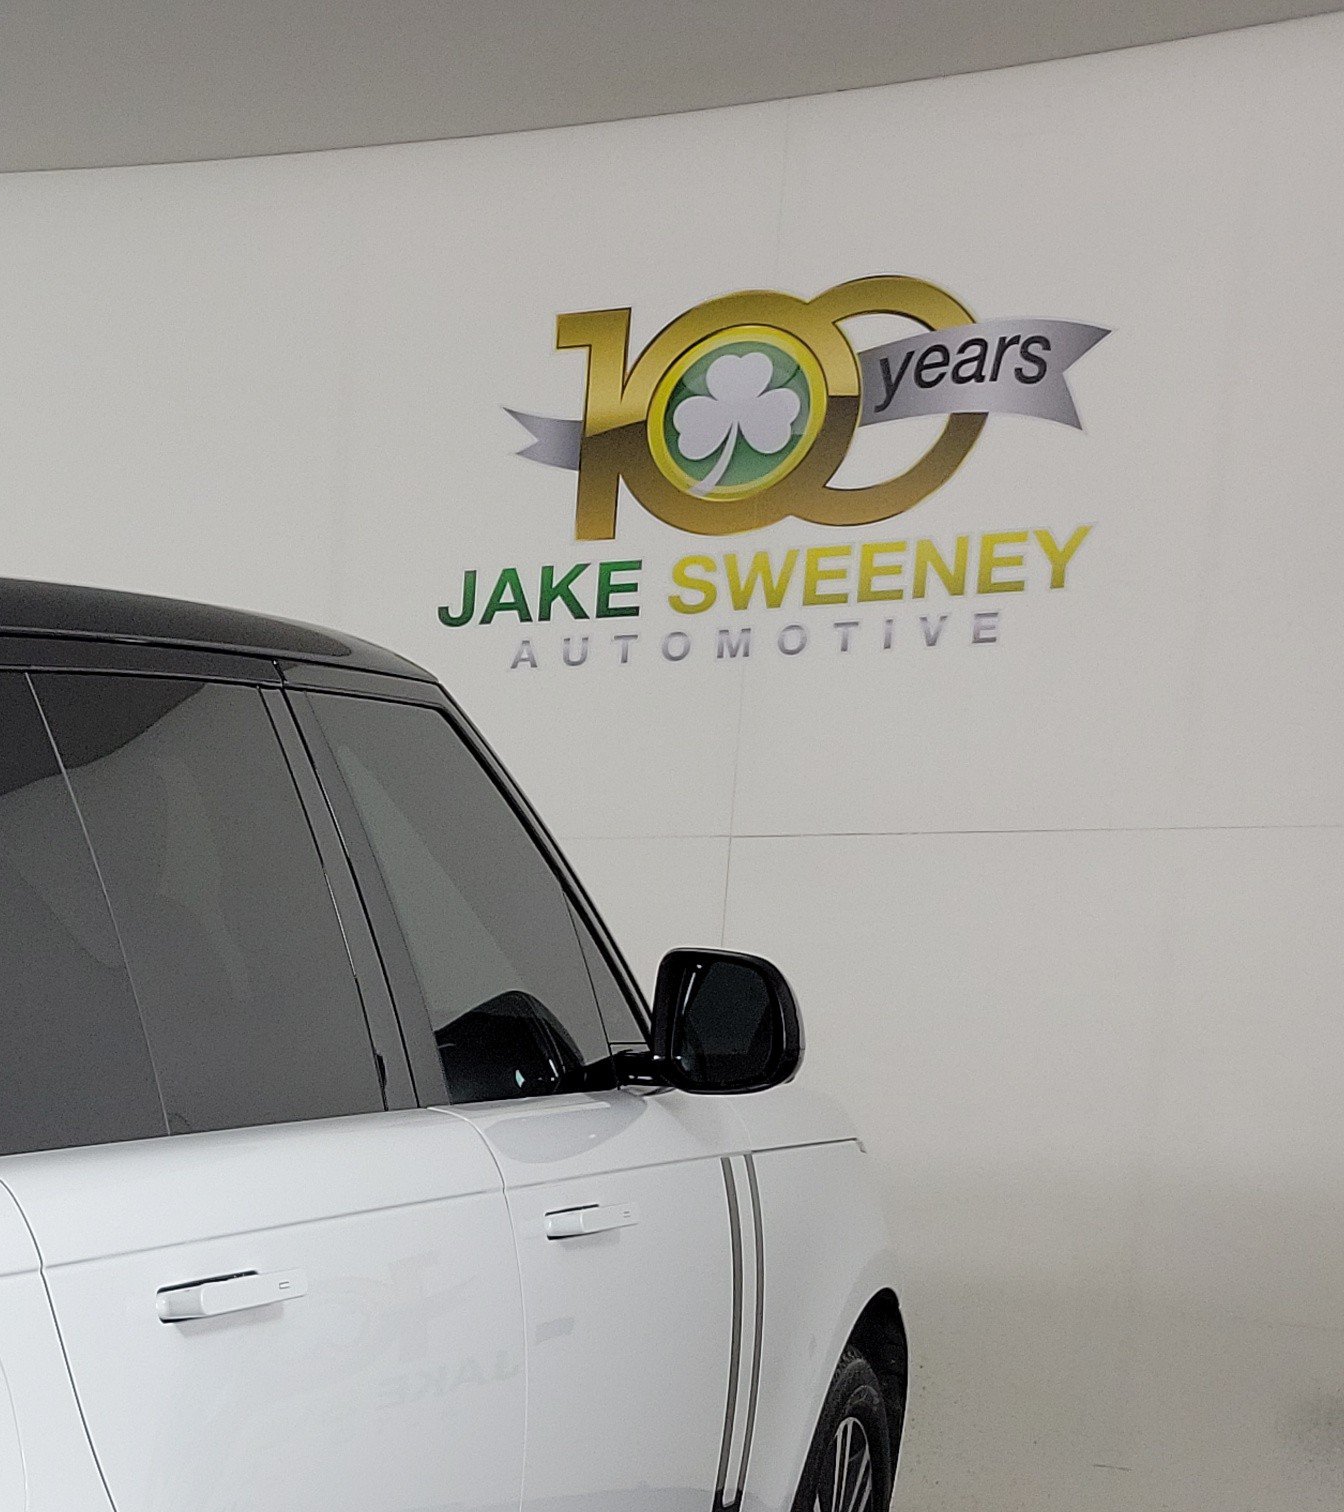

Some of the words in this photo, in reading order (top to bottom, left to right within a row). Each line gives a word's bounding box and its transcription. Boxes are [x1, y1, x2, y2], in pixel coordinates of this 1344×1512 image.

[555, 274, 990, 542] 100
[873, 334, 1053, 413] years
[437, 559, 643, 629] JAKE
[667, 525, 1095, 616] SWEENEY
[510, 612, 1002, 671] AUTOMOTIVE
